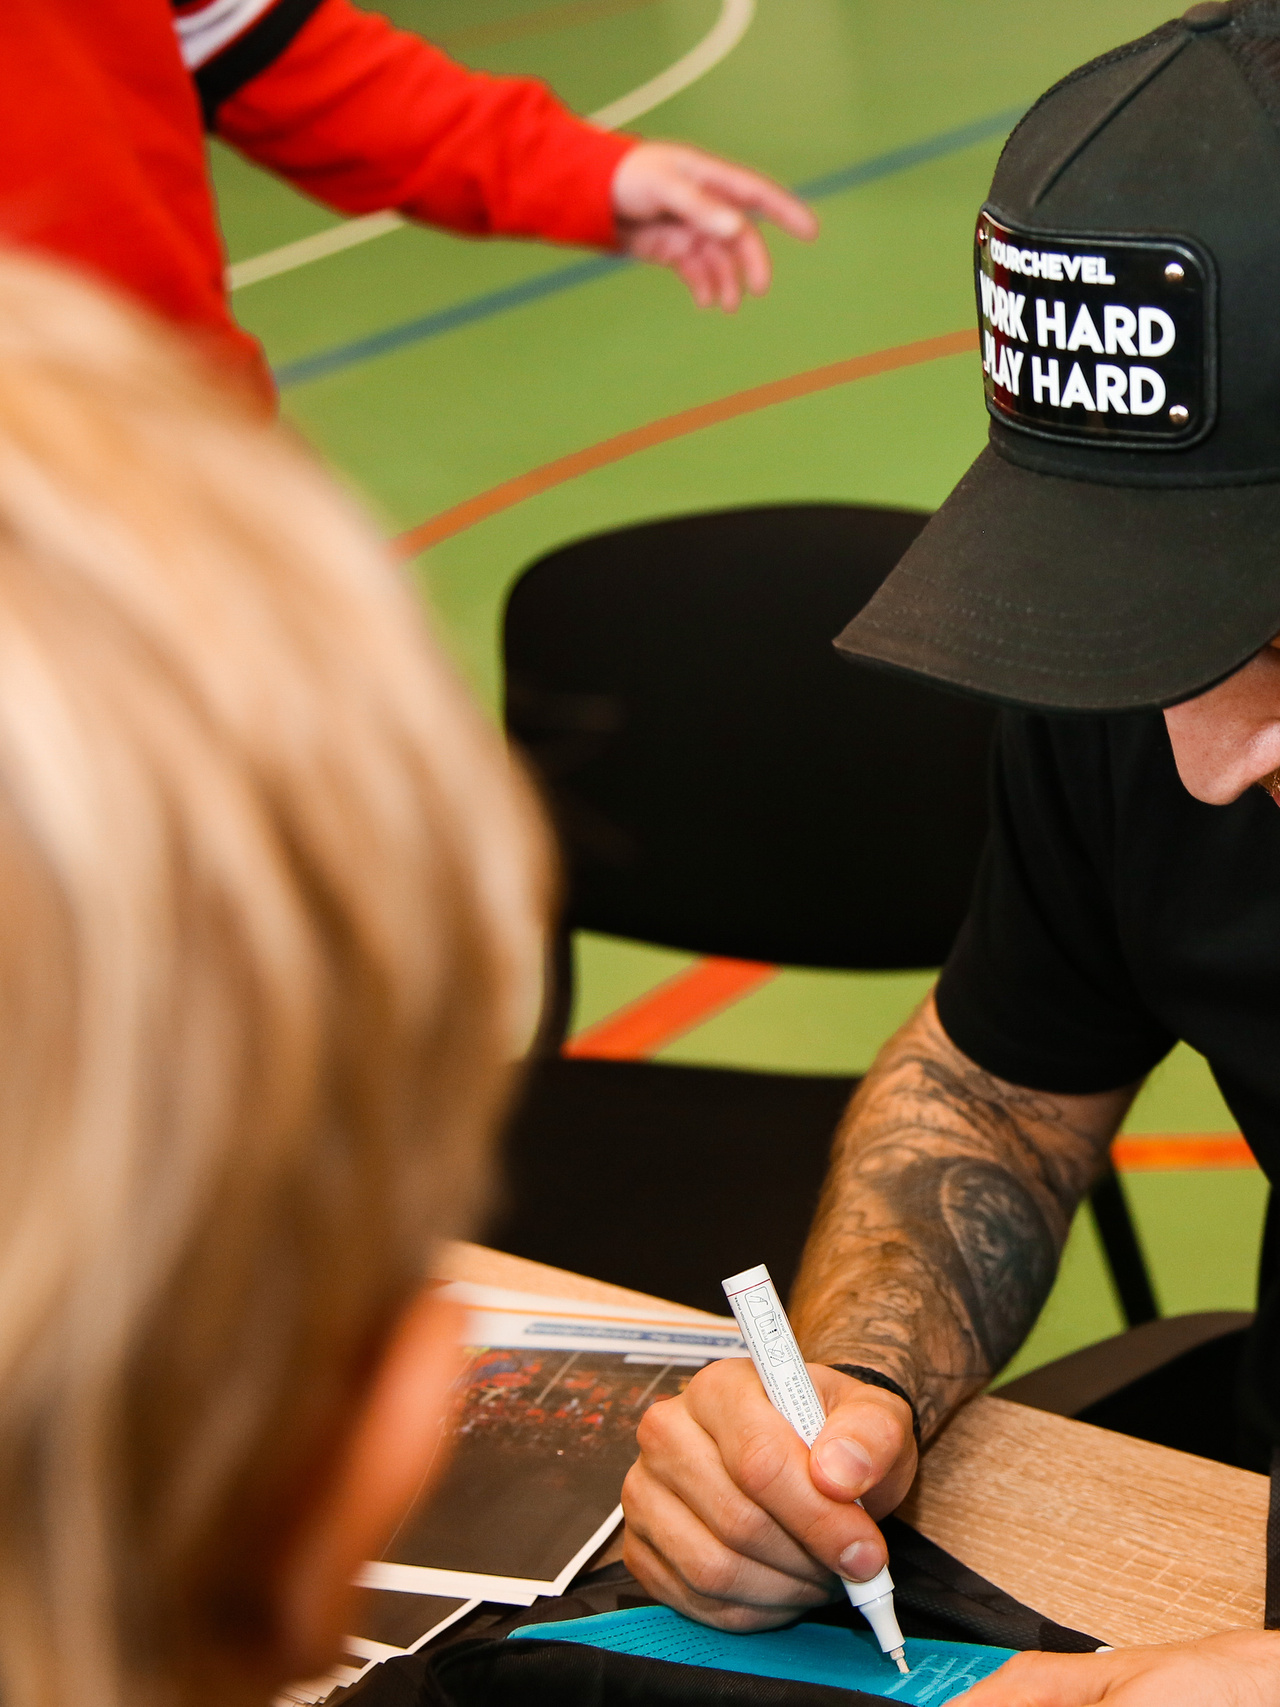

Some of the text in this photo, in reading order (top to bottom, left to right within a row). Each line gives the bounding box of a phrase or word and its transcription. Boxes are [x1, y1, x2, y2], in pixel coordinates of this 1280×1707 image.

[990, 237, 1116, 285] COURCHEVEL
[980, 269, 1176, 357] WORK HARD
[984, 329, 1166, 416] PLAY HARD
